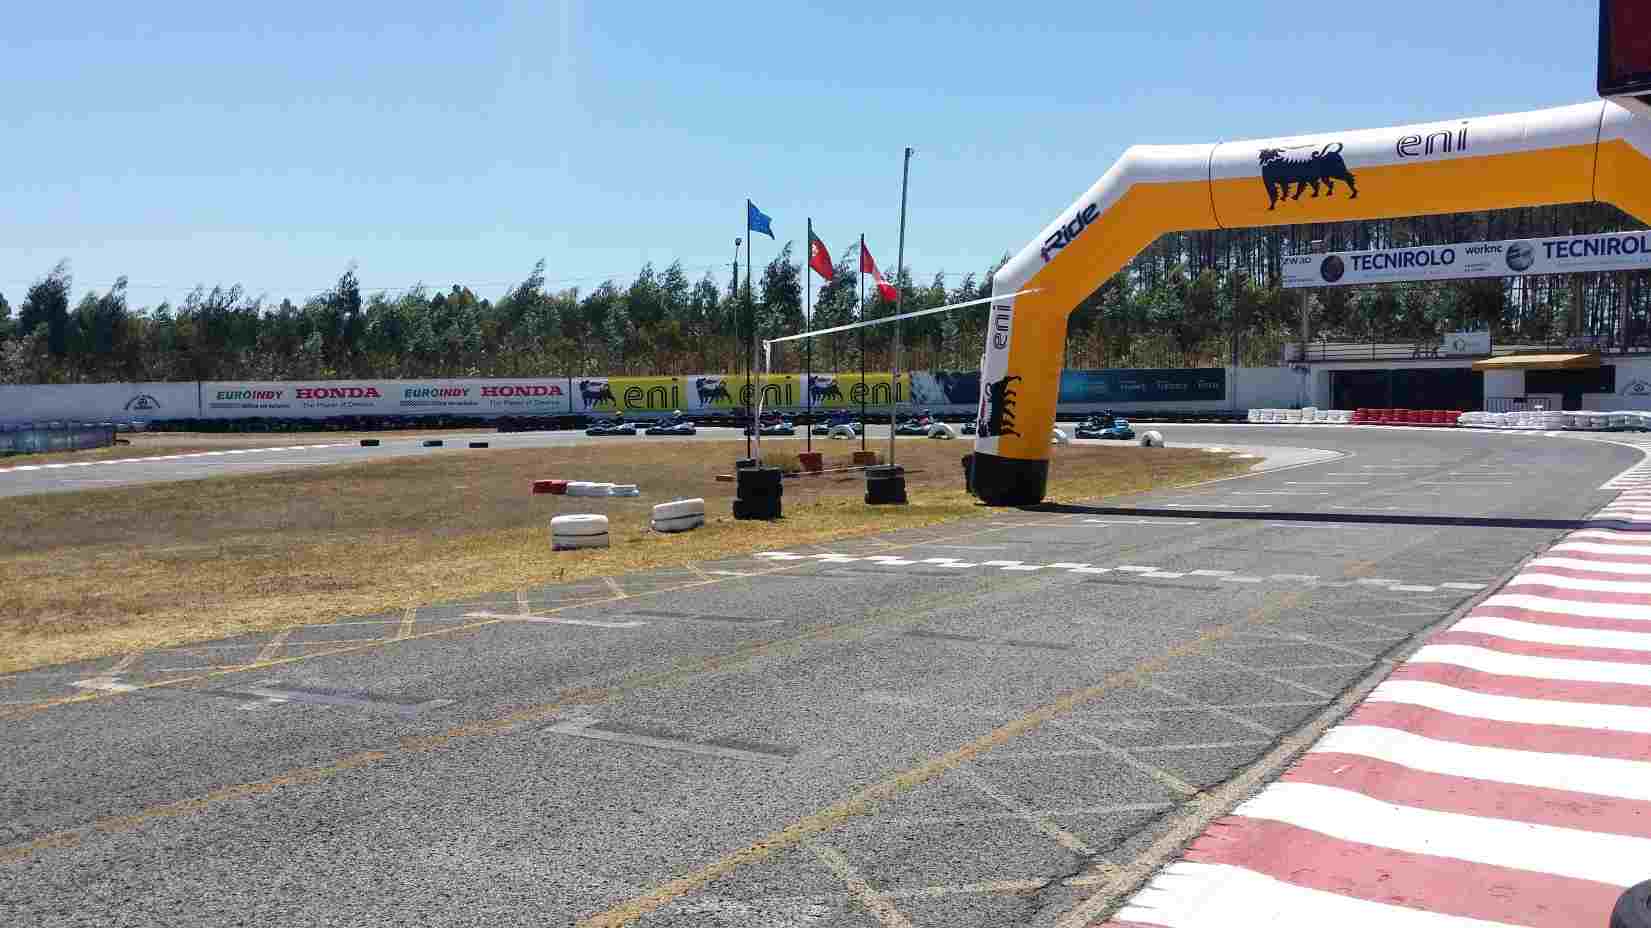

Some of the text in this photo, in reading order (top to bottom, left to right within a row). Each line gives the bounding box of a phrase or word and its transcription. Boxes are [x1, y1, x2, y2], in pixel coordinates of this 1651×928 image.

[1397, 120, 1469, 158] eni
[1351, 248, 1456, 271] TECNIROLO
[992, 304, 1011, 350] eni
[216, 390, 282, 400] EUROINDY
[296, 387, 382, 399] HONDA
[404, 387, 470, 398] EUROINDY
[481, 386, 563, 396] HONDA
[624, 378, 679, 409] eni
[850, 375, 902, 404] eni
